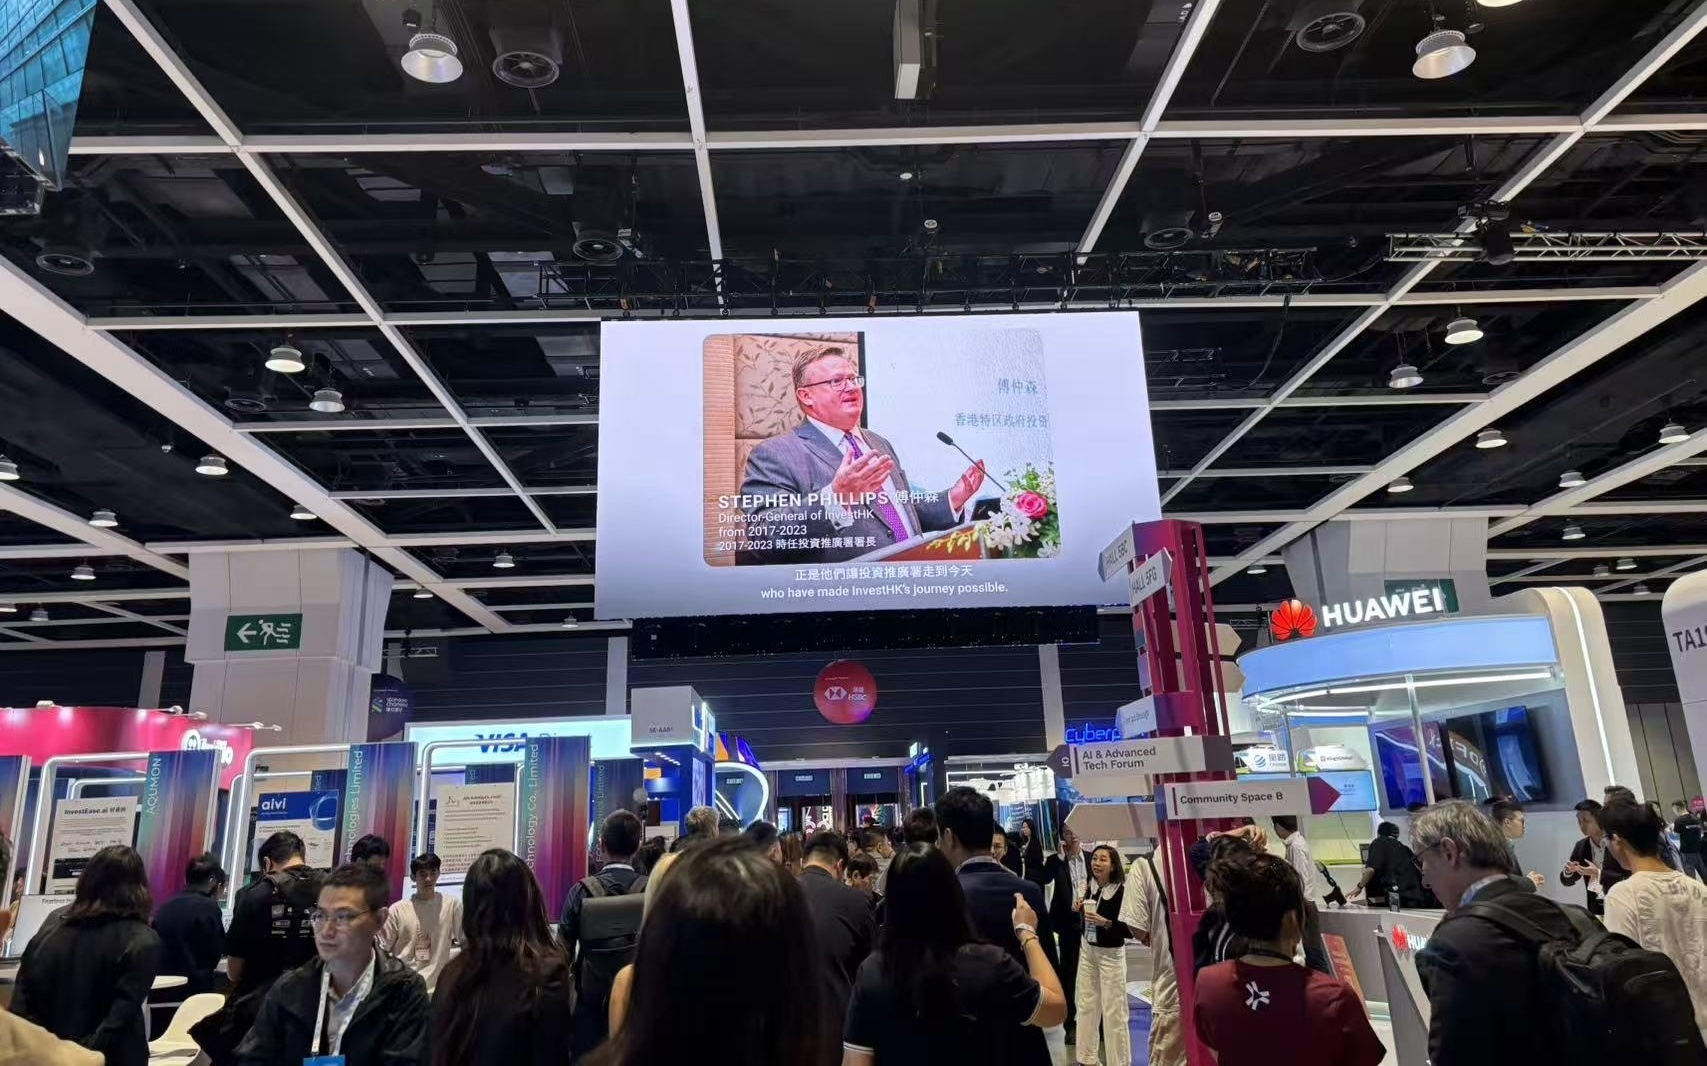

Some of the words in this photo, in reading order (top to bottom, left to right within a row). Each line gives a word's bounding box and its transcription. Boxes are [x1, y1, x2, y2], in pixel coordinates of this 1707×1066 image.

[718, 493, 801, 509] STEPHEN
[807, 491, 888, 507] PHILLIPS
[718, 510, 807, 523] Director-General
[810, 509, 822, 520] of
[824, 509, 875, 521] InvestHK
[718, 526, 745, 537] from
[748, 525, 807, 537] 2017-2023
[719, 540, 773, 551] 2017-2023
[1105, 551, 1119, 566] HALL
[761, 588, 785, 599] who
[787, 586, 815, 598] have
[817, 585, 849, 597] made
[912, 583, 955, 597] journey
[957, 581, 1008, 595] possible.
[1131, 573, 1146, 594] HALL
[1322, 586, 1444, 628] HUAWEI
[475, 732, 528, 754] VISA
[1082, 750, 1093, 760] AI
[1095, 749, 1103, 759] &
[1105, 746, 1156, 759] Advanced
[349, 750, 363, 794] Limited
[528, 744, 539, 787] Limited
[1083, 760, 1108, 771] Tech
[1110, 758, 1145, 770] Forum
[146, 758, 162, 815] AQUMON
[261, 797, 287, 811] aivi
[527, 793, 538, 811] Co.
[1180, 793, 1239, 805] Community
[1241, 791, 1273, 804] Space
[1275, 791, 1284, 801] B
